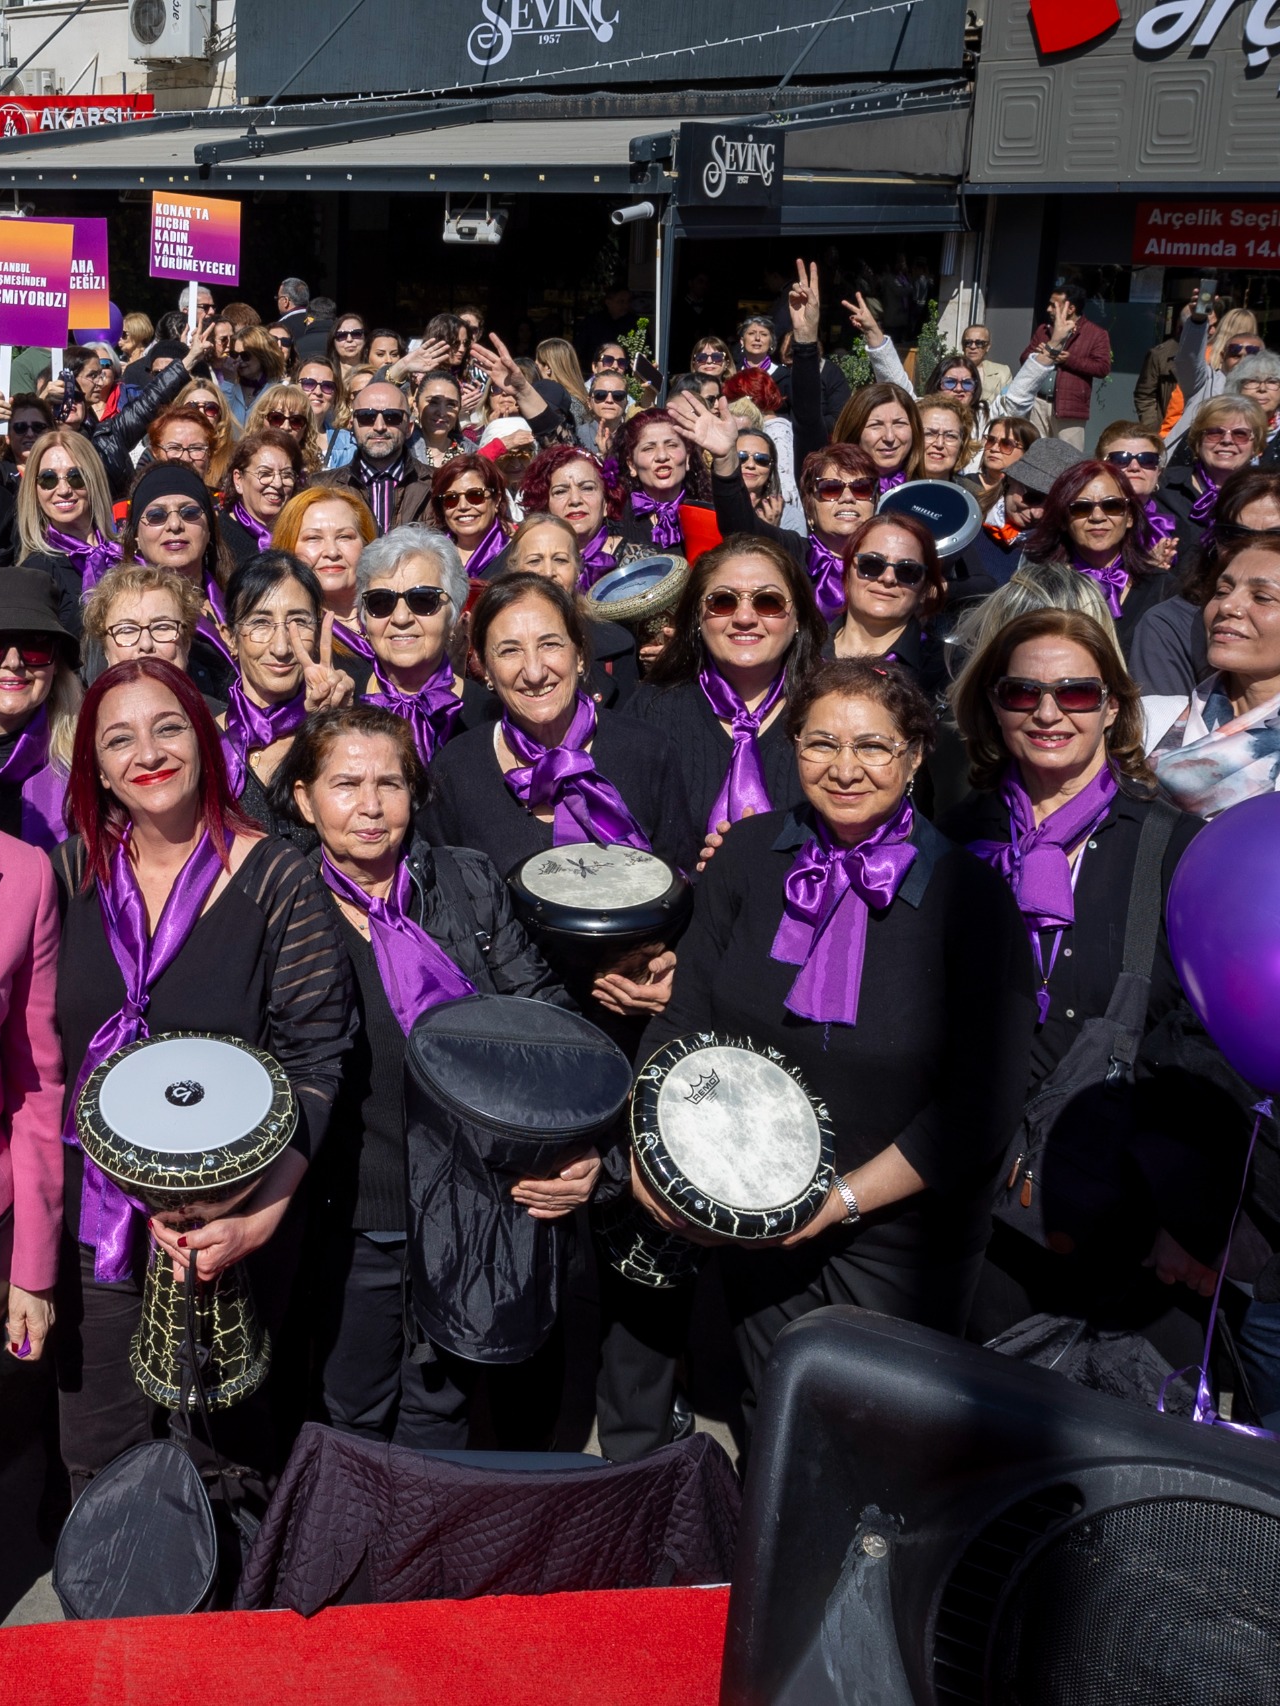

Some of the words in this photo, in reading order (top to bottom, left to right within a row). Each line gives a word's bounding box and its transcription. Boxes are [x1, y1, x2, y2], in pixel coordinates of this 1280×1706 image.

[538, 34, 561, 45] 1957
[155, 202, 209, 220] KONAK'TA
[1148, 208, 1222, 229] Arçelik
[154, 229, 188, 244] KADIN
[154, 242, 194, 258] YALNIZ
[1145, 238, 1237, 257] Alımında
[1245, 240, 1280, 257] 14.
[71, 260, 94, 273] AHA
[154, 255, 236, 276] YÜRÜMEYECEK!
[692, 1076, 717, 1101] REMO
